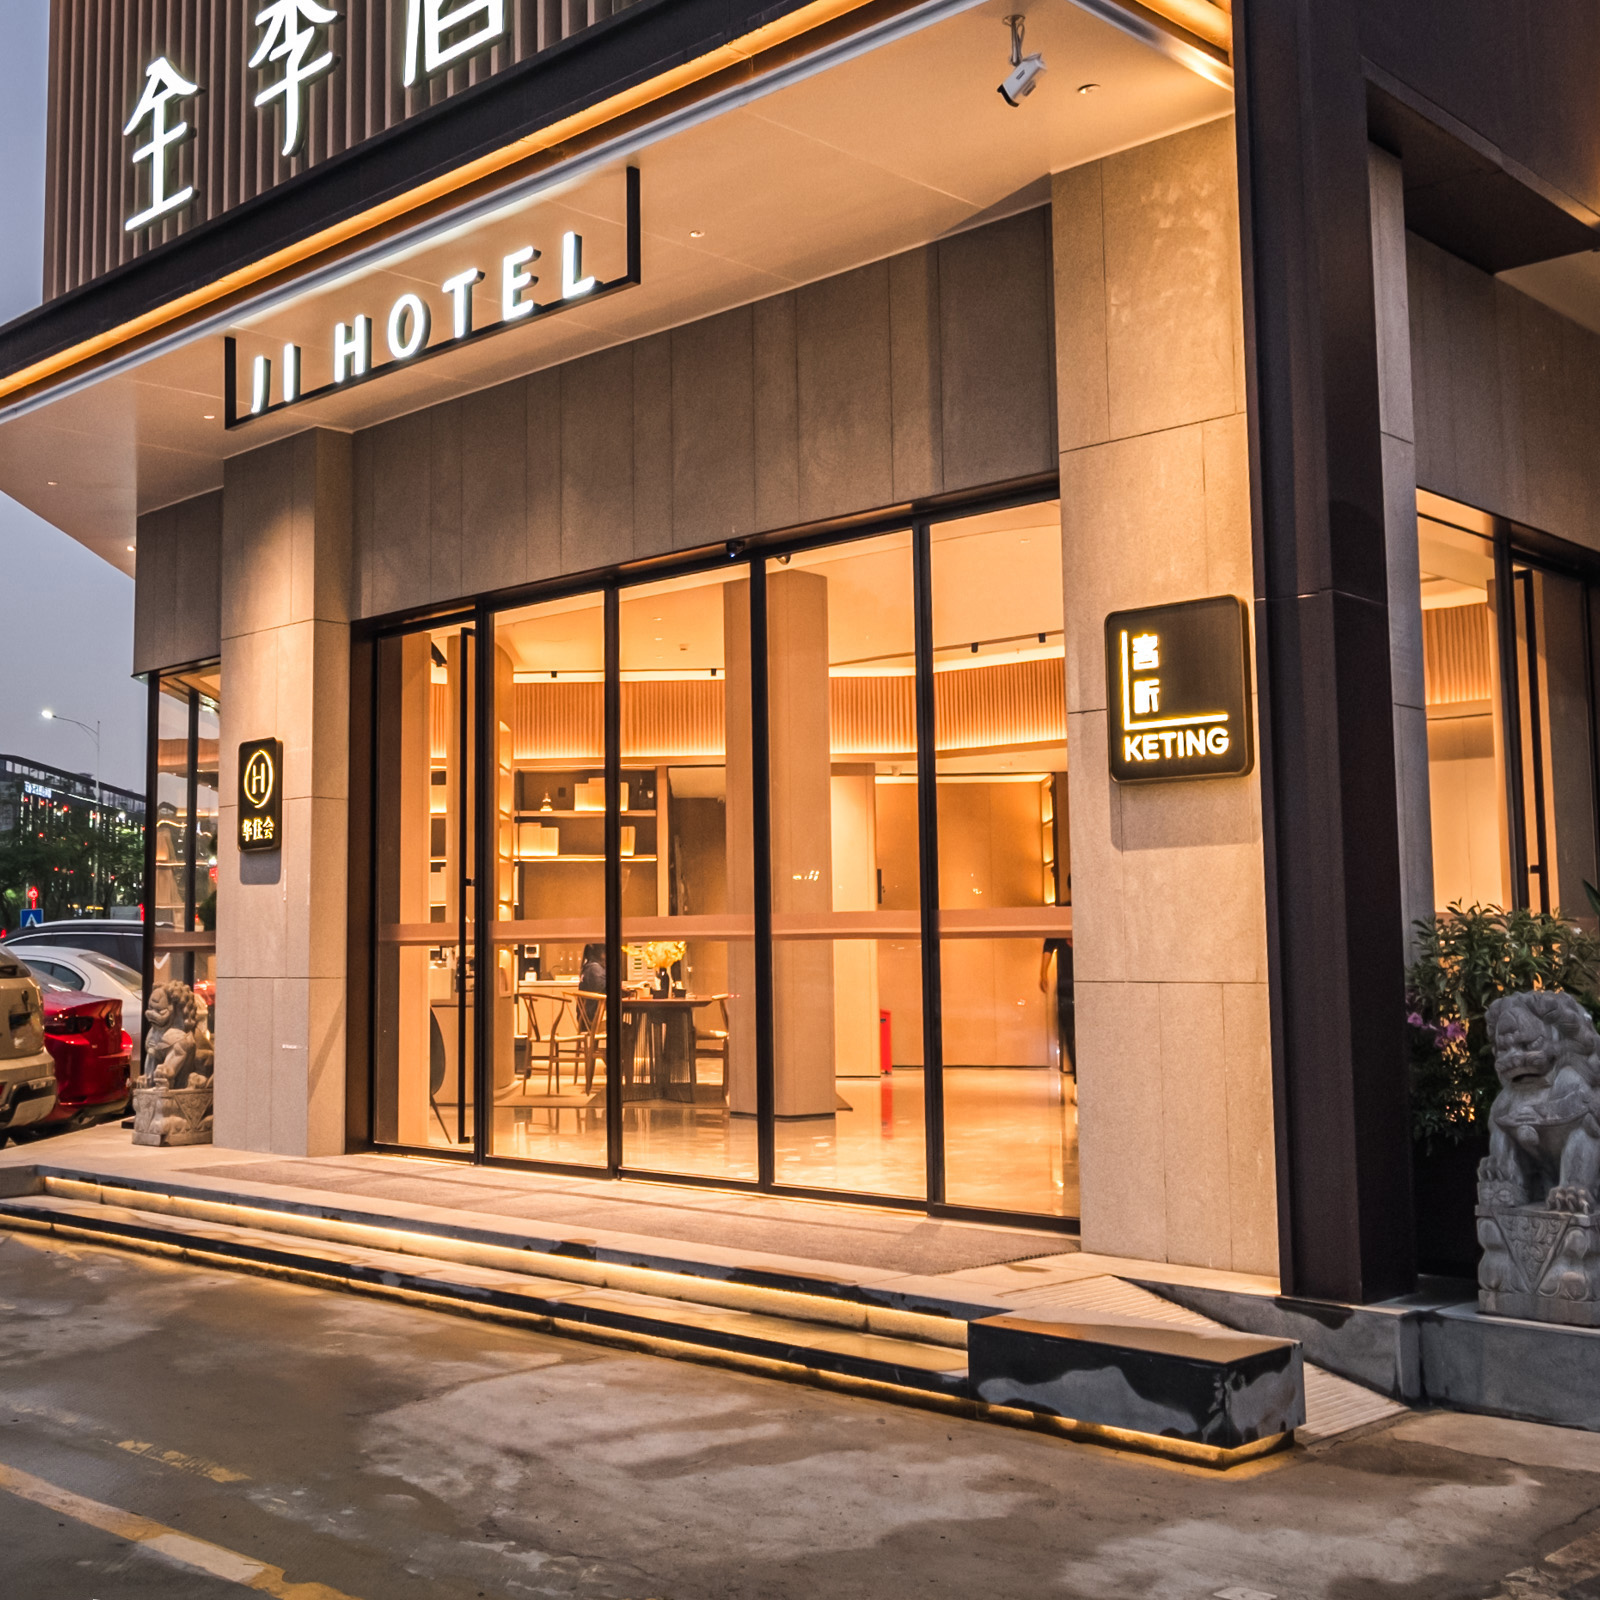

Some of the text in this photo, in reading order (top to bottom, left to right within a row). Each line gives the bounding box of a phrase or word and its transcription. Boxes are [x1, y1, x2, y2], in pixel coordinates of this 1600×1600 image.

[333, 229, 598, 384] HOTEL
[1123, 726, 1230, 763] KETING
[242, 816, 275, 842] 华住会
